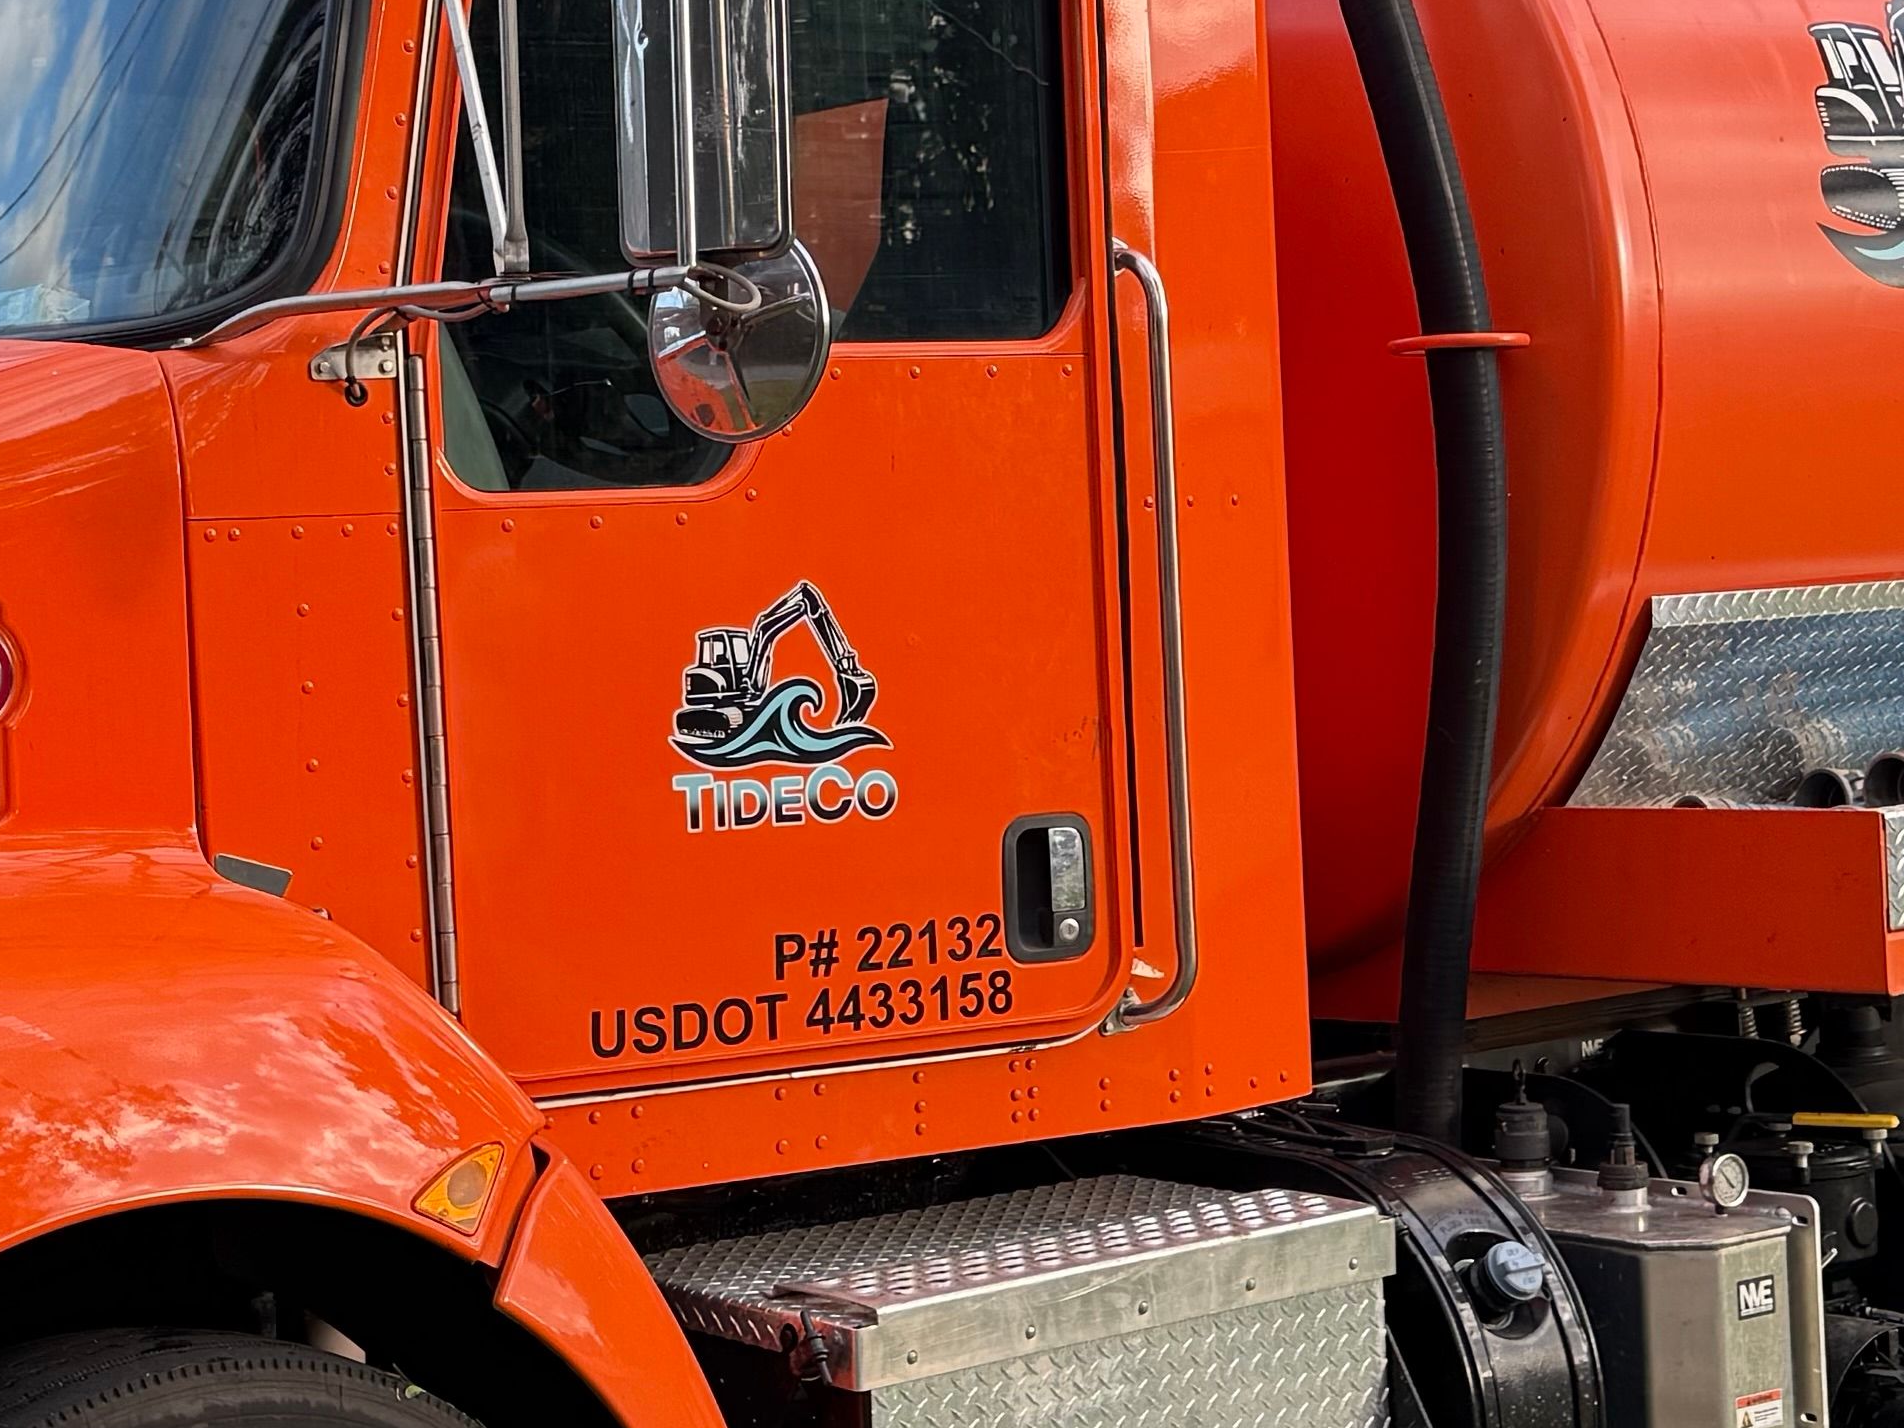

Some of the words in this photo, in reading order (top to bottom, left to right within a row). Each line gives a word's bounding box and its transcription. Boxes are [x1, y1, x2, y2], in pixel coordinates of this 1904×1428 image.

[774, 928, 840, 981] P#
[856, 913, 1003, 972] 22132
[590, 993, 788, 1059] USDOT
[805, 970, 1014, 1036] 4433158
